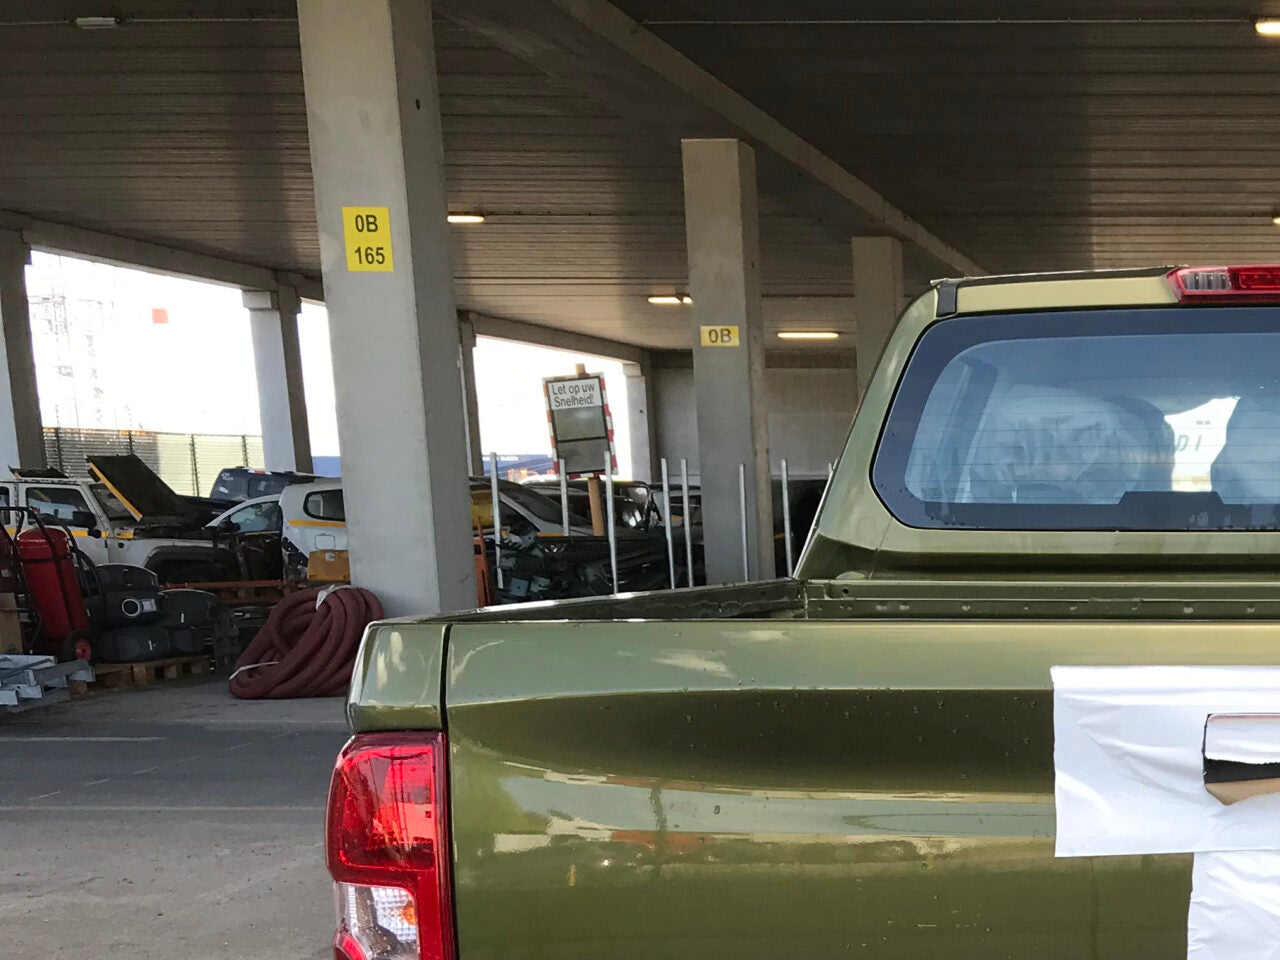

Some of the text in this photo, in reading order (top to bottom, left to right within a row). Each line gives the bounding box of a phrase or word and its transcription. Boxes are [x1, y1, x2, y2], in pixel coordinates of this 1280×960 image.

[355, 214, 378, 232] 0B
[354, 246, 386, 264] 165
[551, 383, 595, 395] Let op uw
[554, 394, 595, 408] Snelheid!
